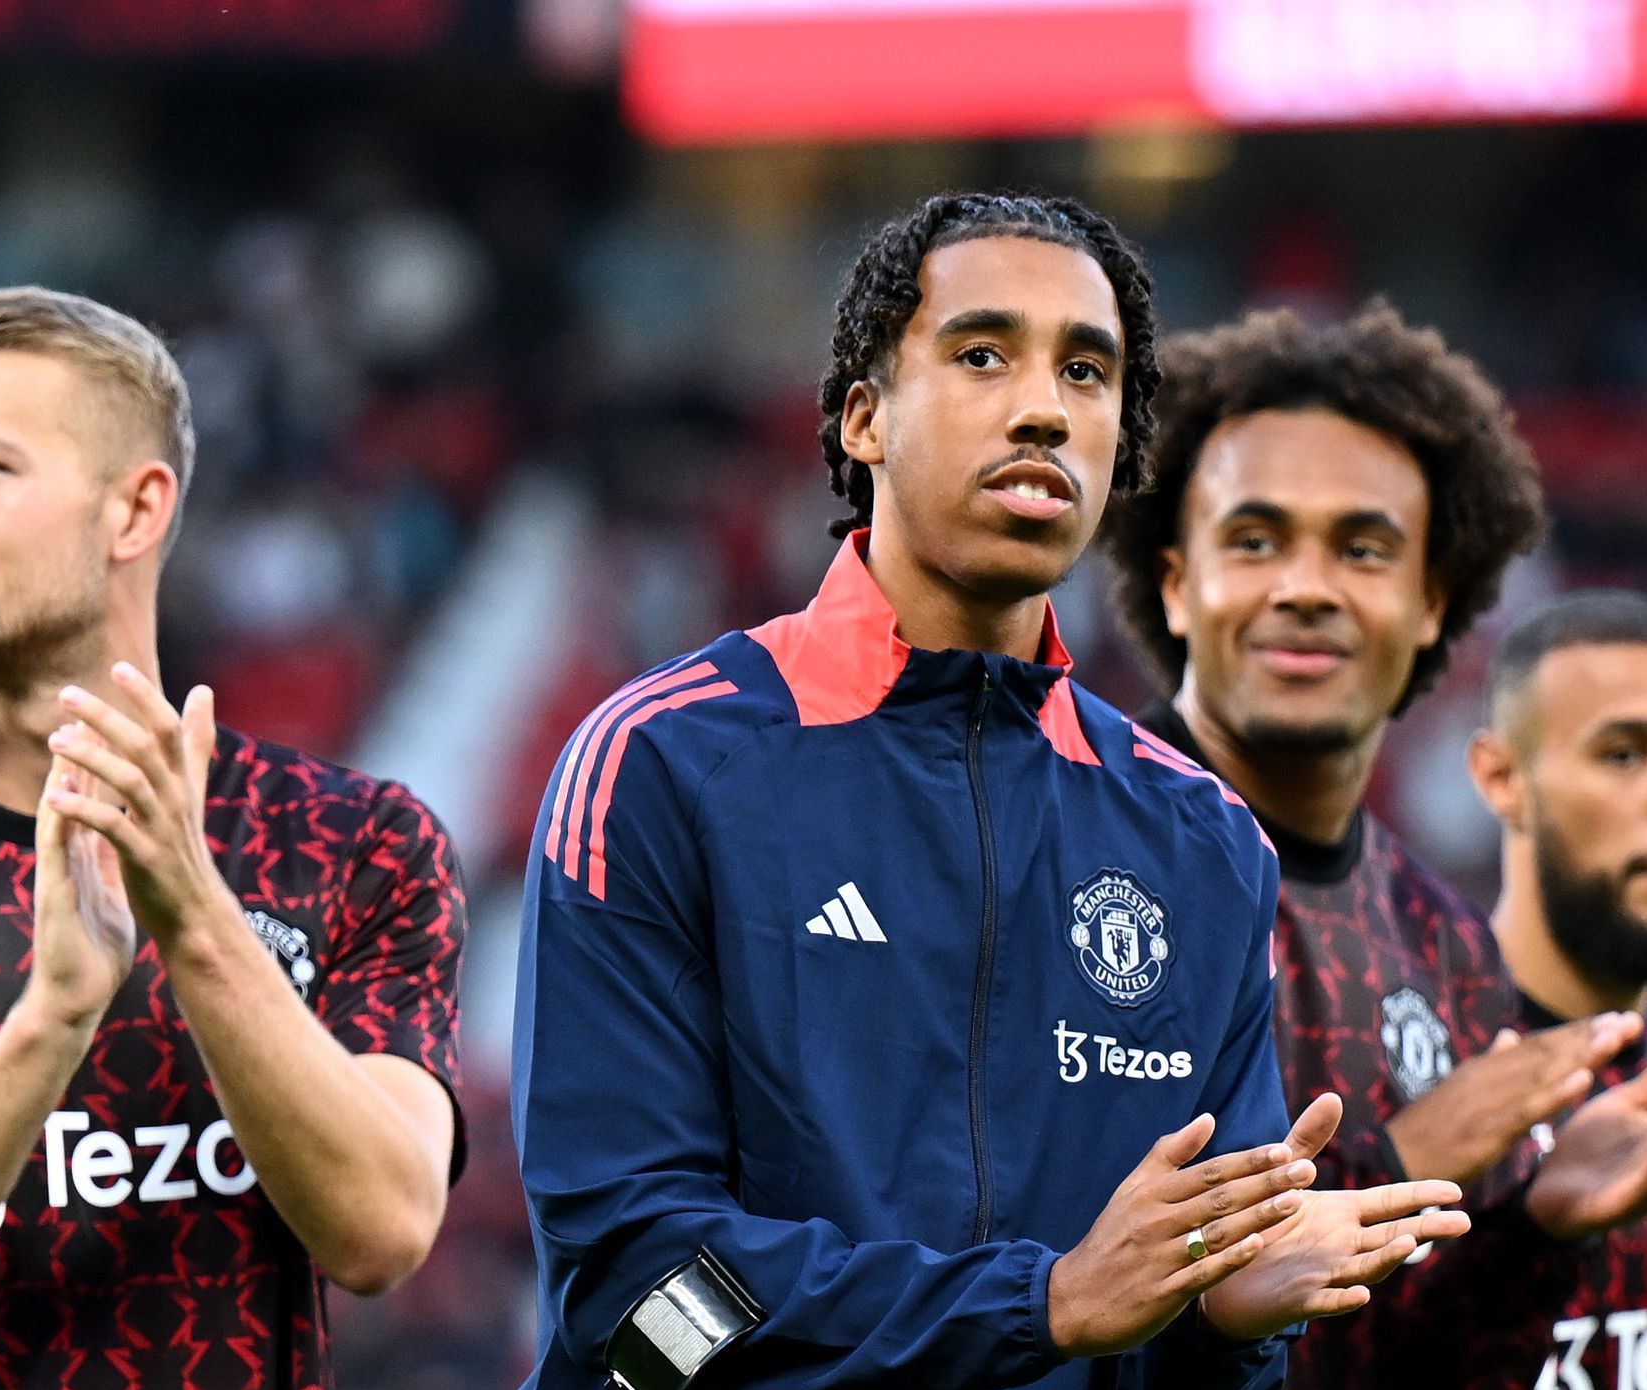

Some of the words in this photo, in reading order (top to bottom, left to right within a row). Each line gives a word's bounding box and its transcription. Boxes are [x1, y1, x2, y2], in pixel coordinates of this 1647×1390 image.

[1080, 885, 1157, 930] MANCHESTER
[1094, 965, 1149, 991] UNITED
[1093, 1034, 1193, 1080] Tezos
[44, 1111, 258, 1208] Tezo
